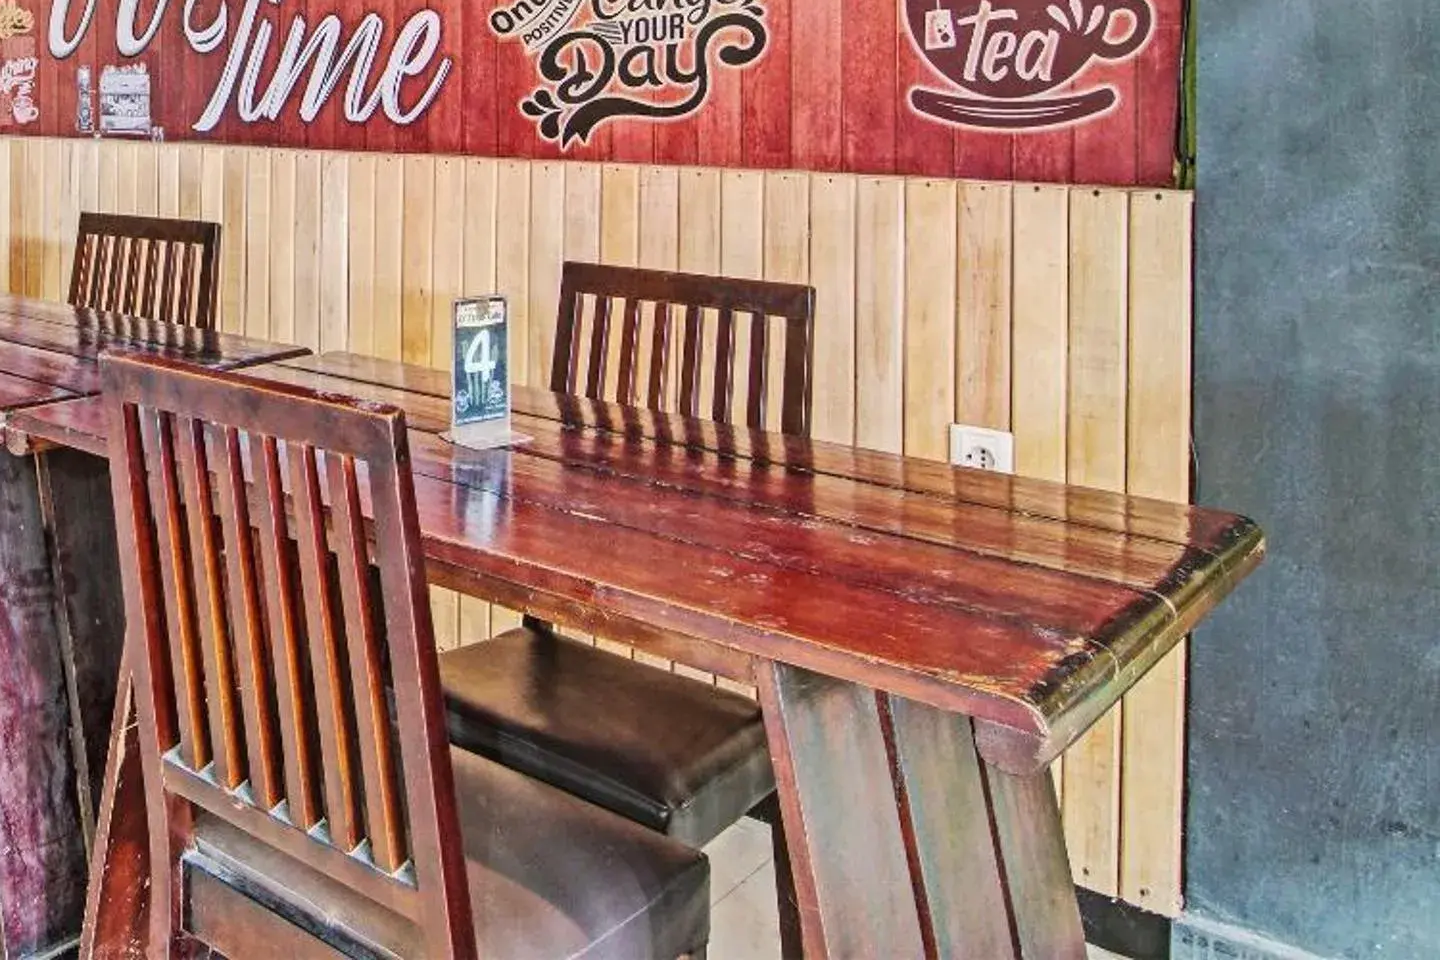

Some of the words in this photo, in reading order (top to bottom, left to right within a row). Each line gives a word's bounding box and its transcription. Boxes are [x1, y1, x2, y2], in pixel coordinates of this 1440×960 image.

[620, 14, 685, 44] YOUR
[957, 0, 1061, 82] tea
[540, 13, 767, 149] Day
[464, 329, 496, 381] 4
